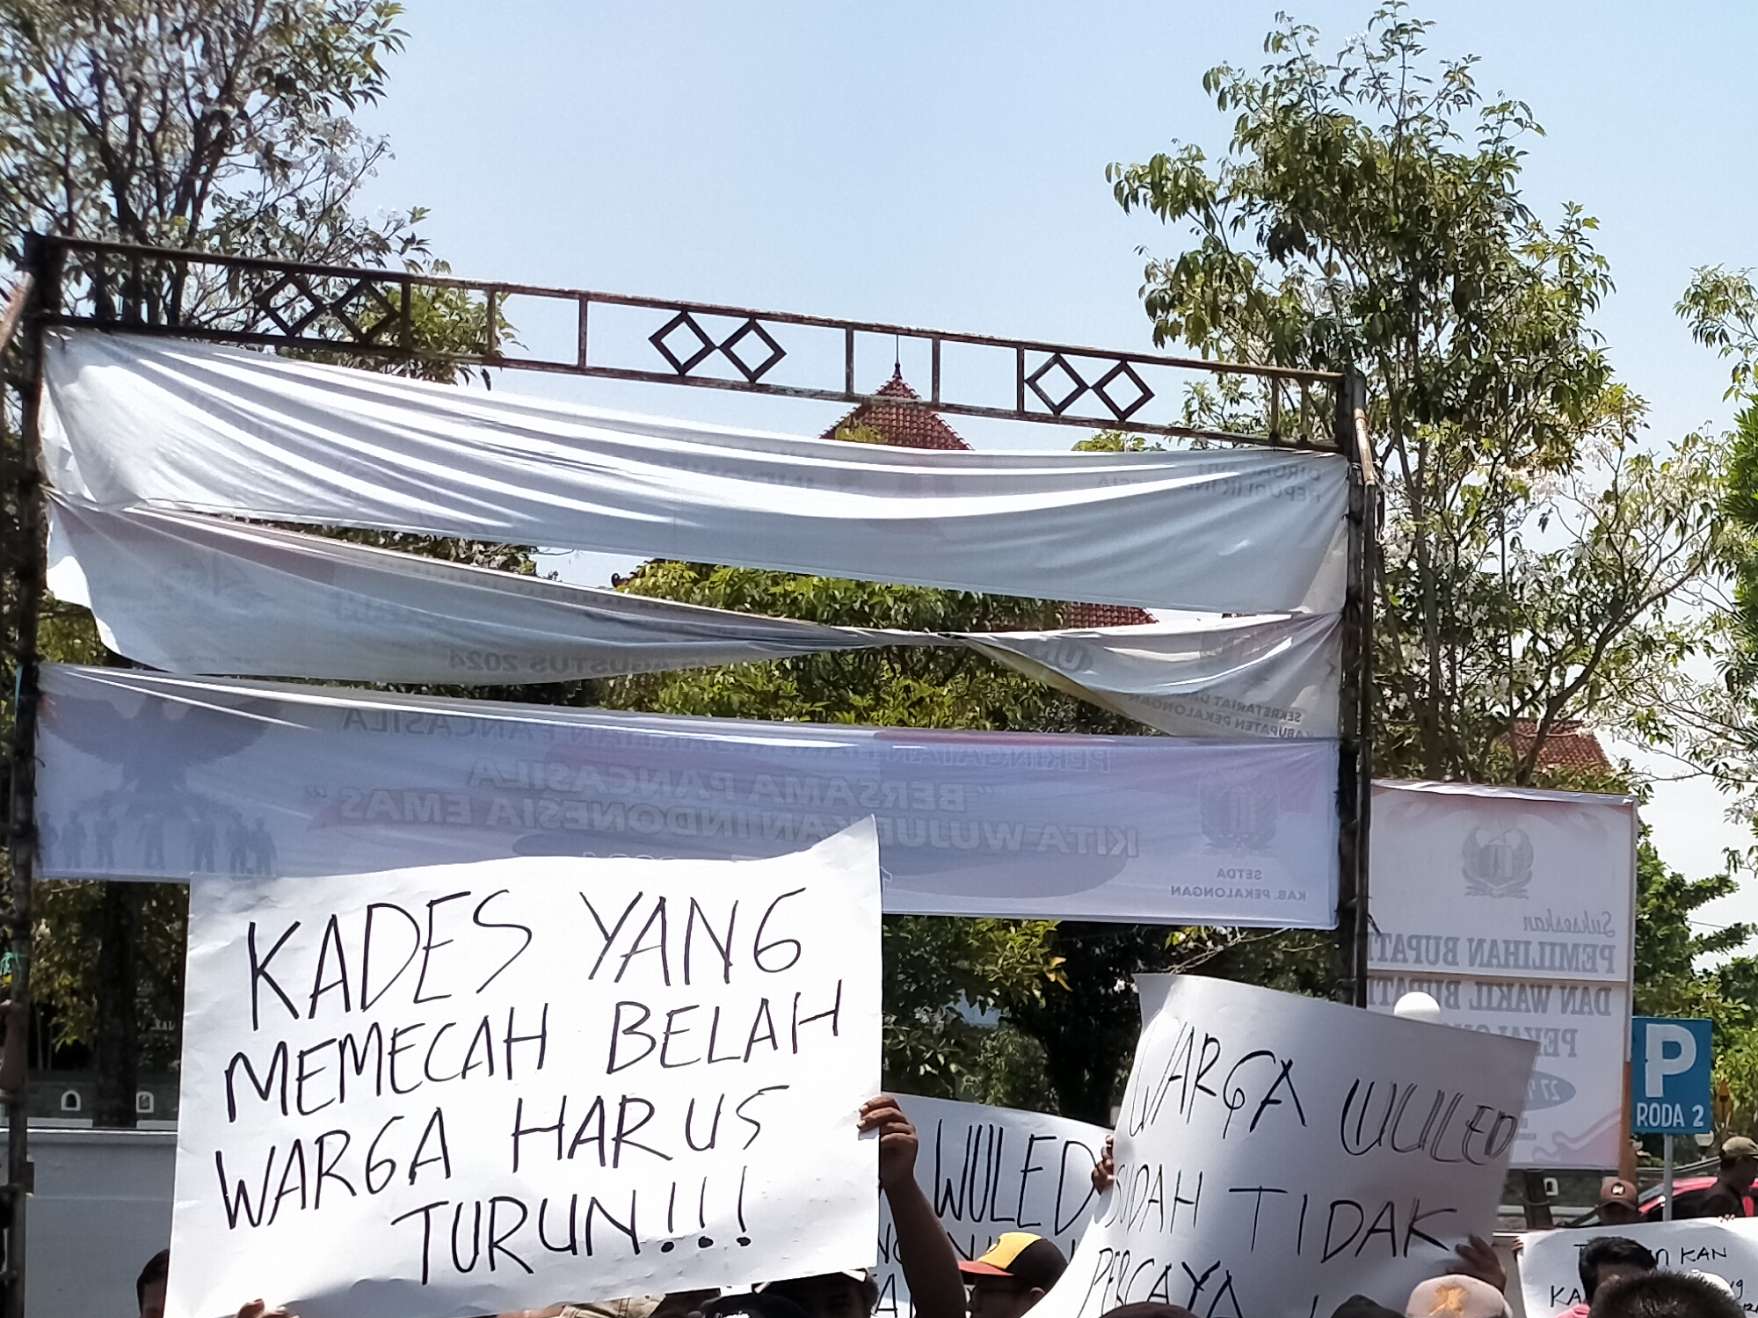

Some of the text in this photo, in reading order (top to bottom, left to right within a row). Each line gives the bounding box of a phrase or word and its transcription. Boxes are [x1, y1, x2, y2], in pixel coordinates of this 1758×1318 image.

[249, 886, 807, 1032] KADES YANG
[225, 978, 843, 1123] MEMECAH BELAH
[1126, 1020, 1307, 1139] WARGA
[1644, 1023, 1698, 1099] P
[215, 1084, 790, 1231] WARGA HARUS
[1636, 1103, 1704, 1128] RODA 2
[390, 1165, 753, 1286] TURUN!!!
[934, 1118, 1097, 1237] WULED
[1228, 1184, 1459, 1264] TIDAK
